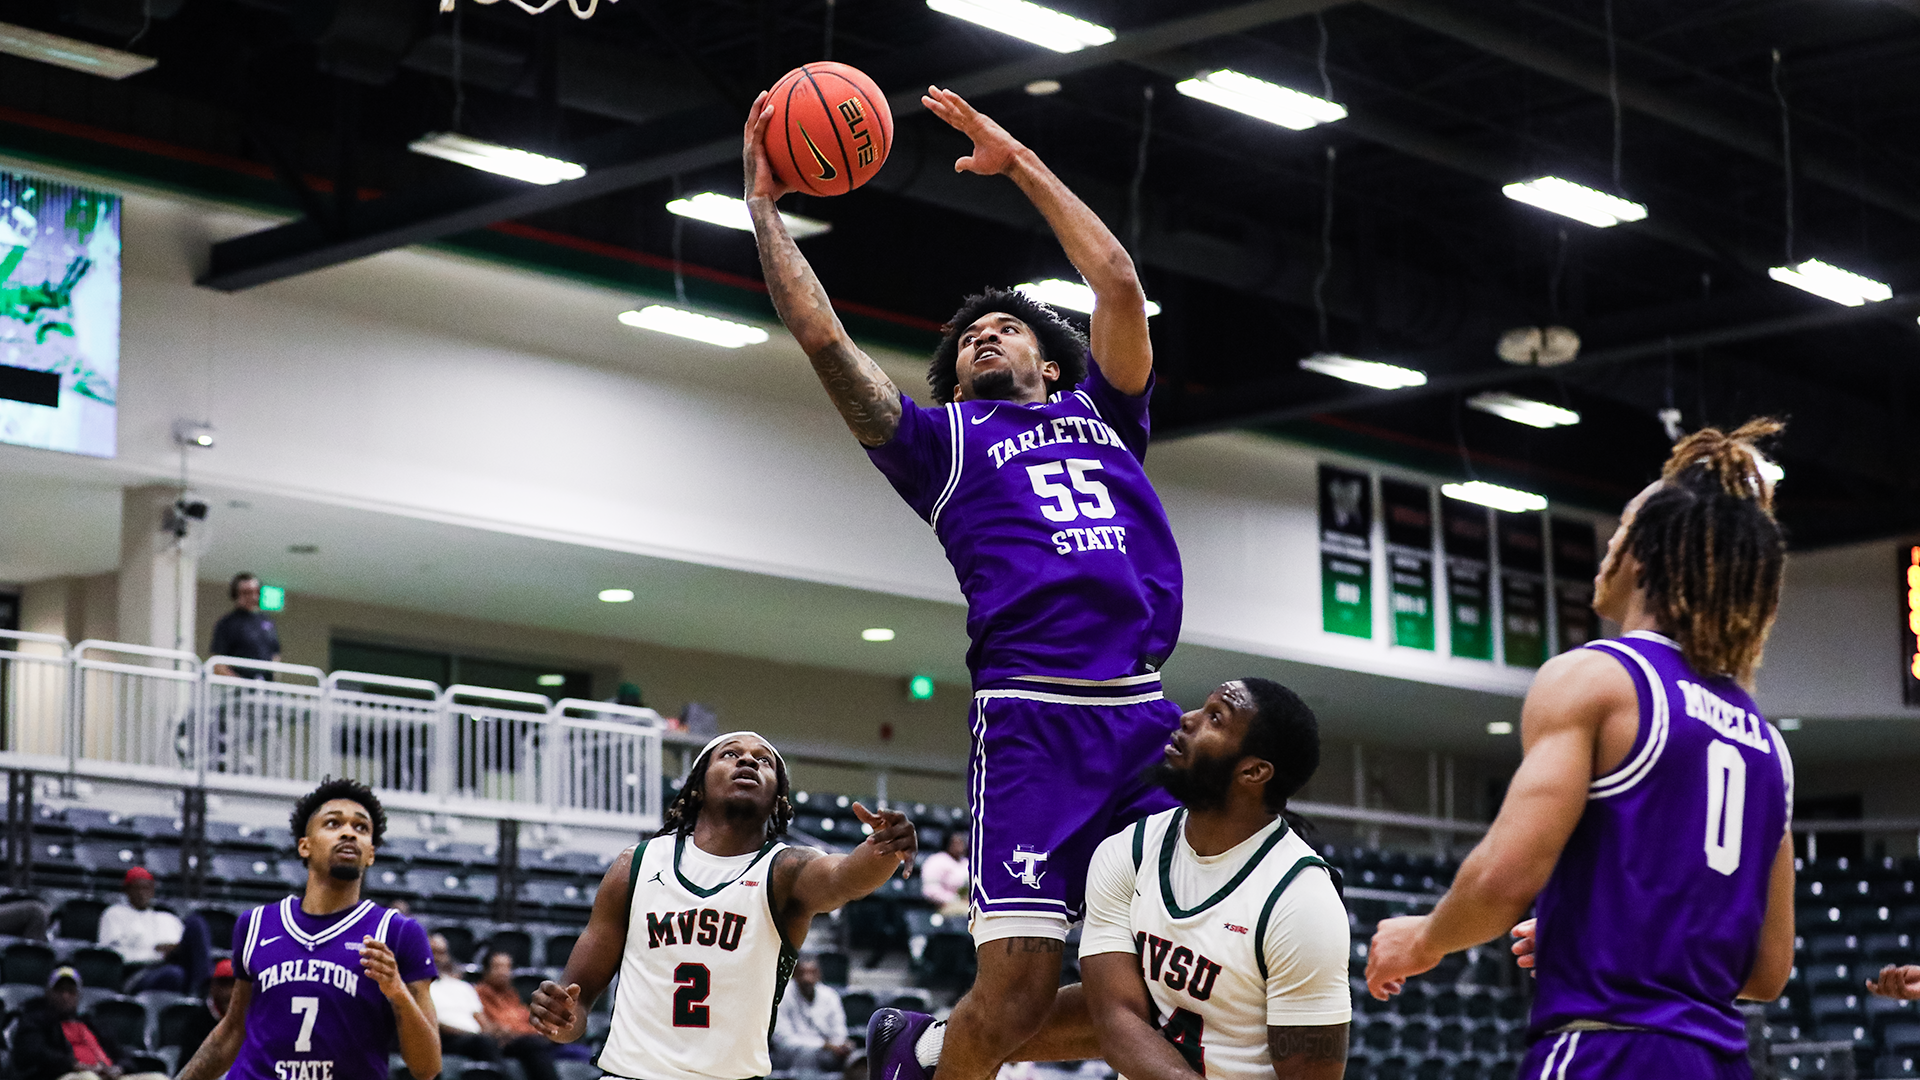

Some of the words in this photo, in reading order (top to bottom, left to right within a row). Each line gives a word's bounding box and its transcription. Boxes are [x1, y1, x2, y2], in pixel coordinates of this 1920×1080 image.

[837, 98, 874, 168] ELITE
[987, 416, 1127, 470] TARLETON
[1025, 458, 1116, 522] 55
[1051, 525, 1127, 555] STATE
[1676, 680, 1771, 754] MIZELL
[1704, 738, 1747, 876] 0
[646, 908, 747, 952] MVSU
[258, 959, 359, 997] TARLETON
[673, 962, 711, 1028] 2
[291, 996, 319, 1052] 7
[275, 1060, 334, 1080] STATE
